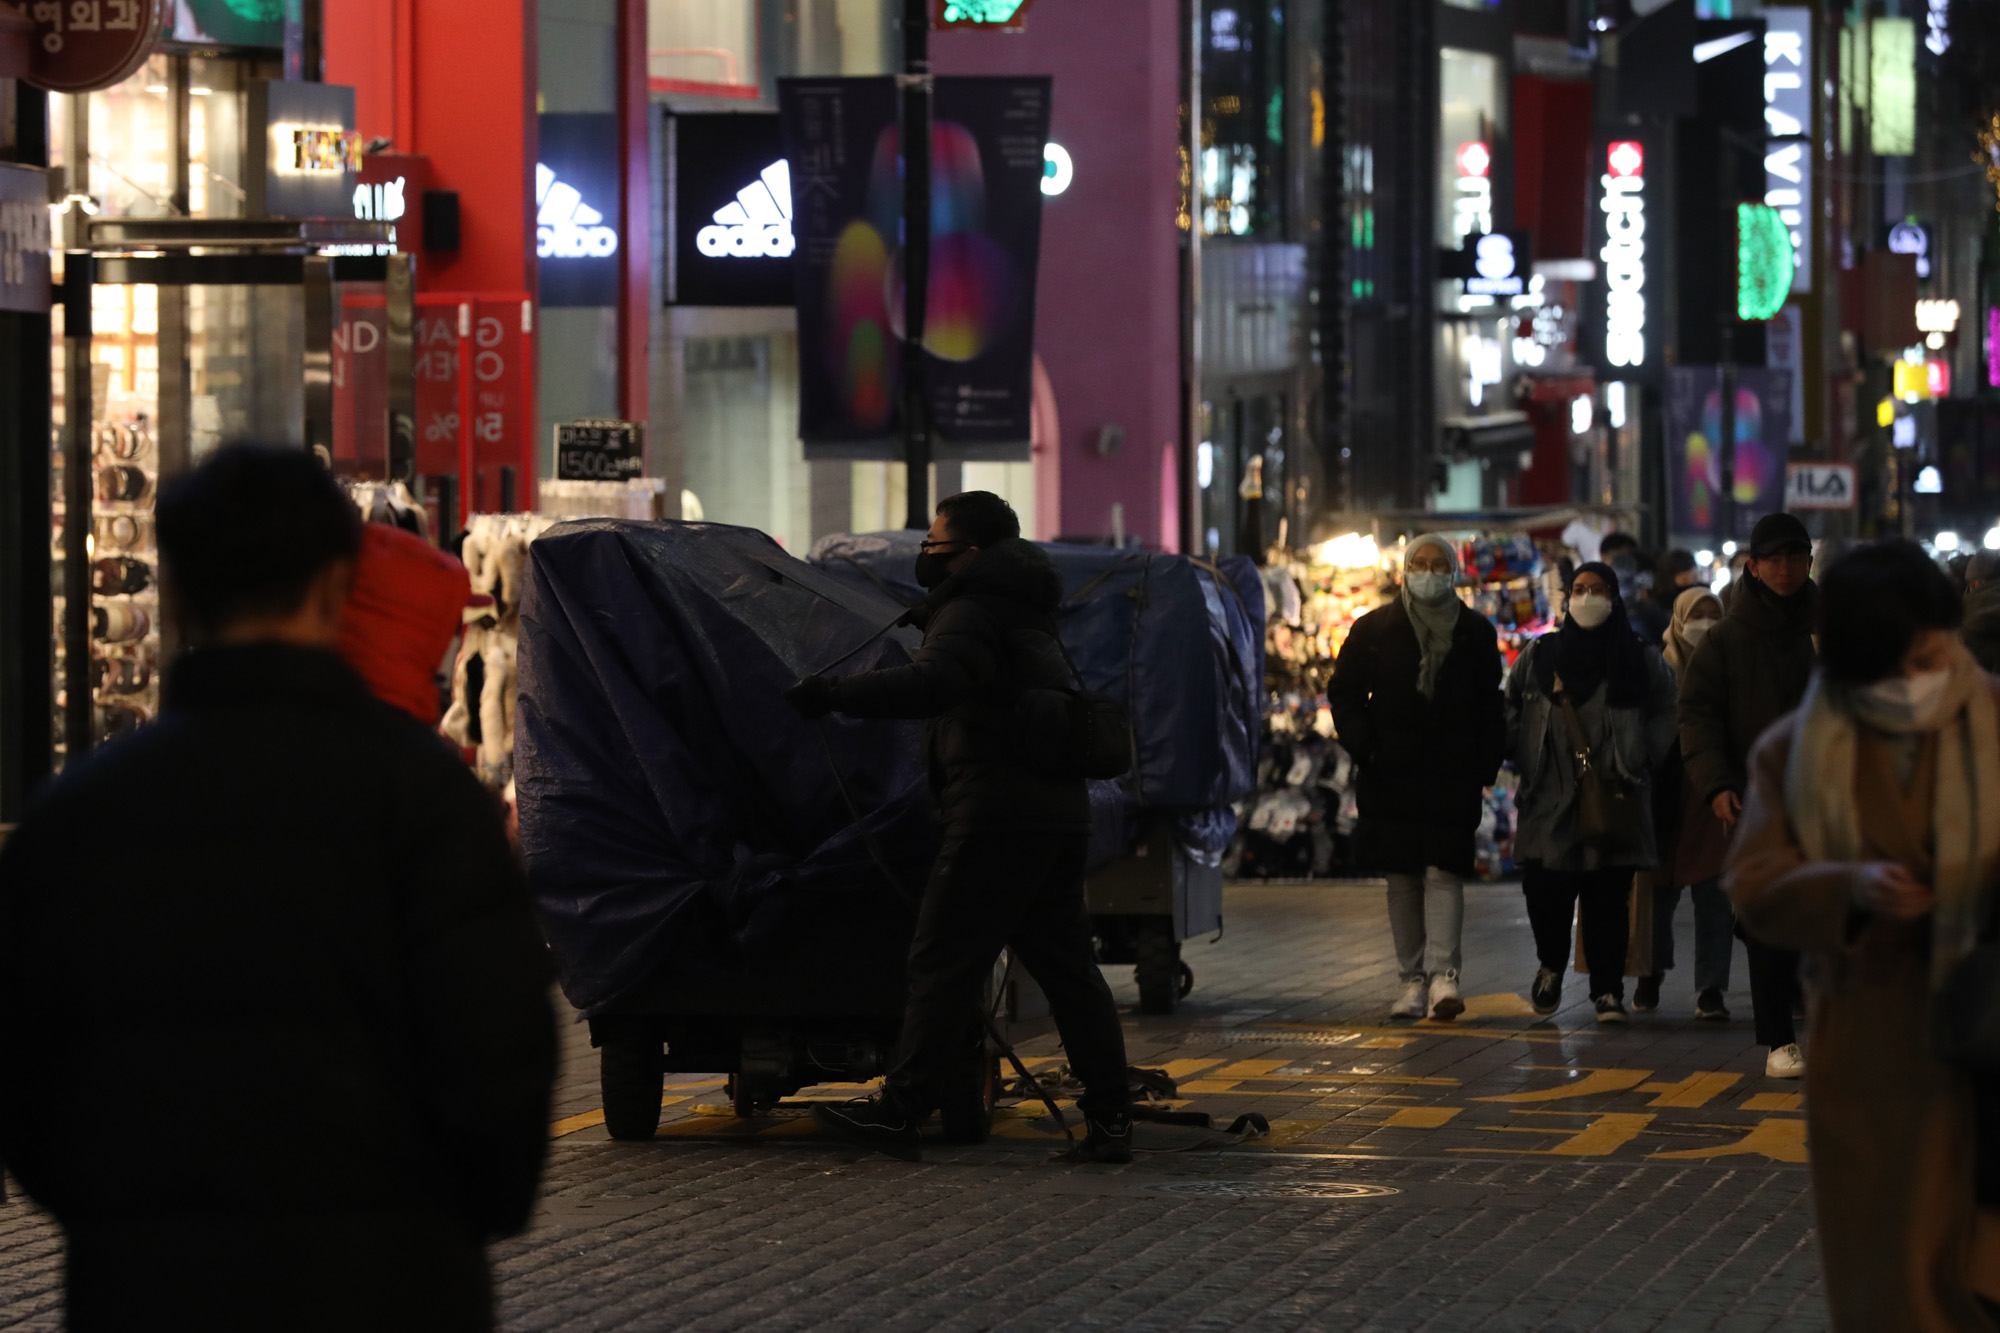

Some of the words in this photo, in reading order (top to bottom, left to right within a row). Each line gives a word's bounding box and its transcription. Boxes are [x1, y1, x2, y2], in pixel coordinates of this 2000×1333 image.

[21, 0, 141, 54] 형외과
[696, 222, 796, 258] adid
[1787, 468, 1848, 496] ILA
